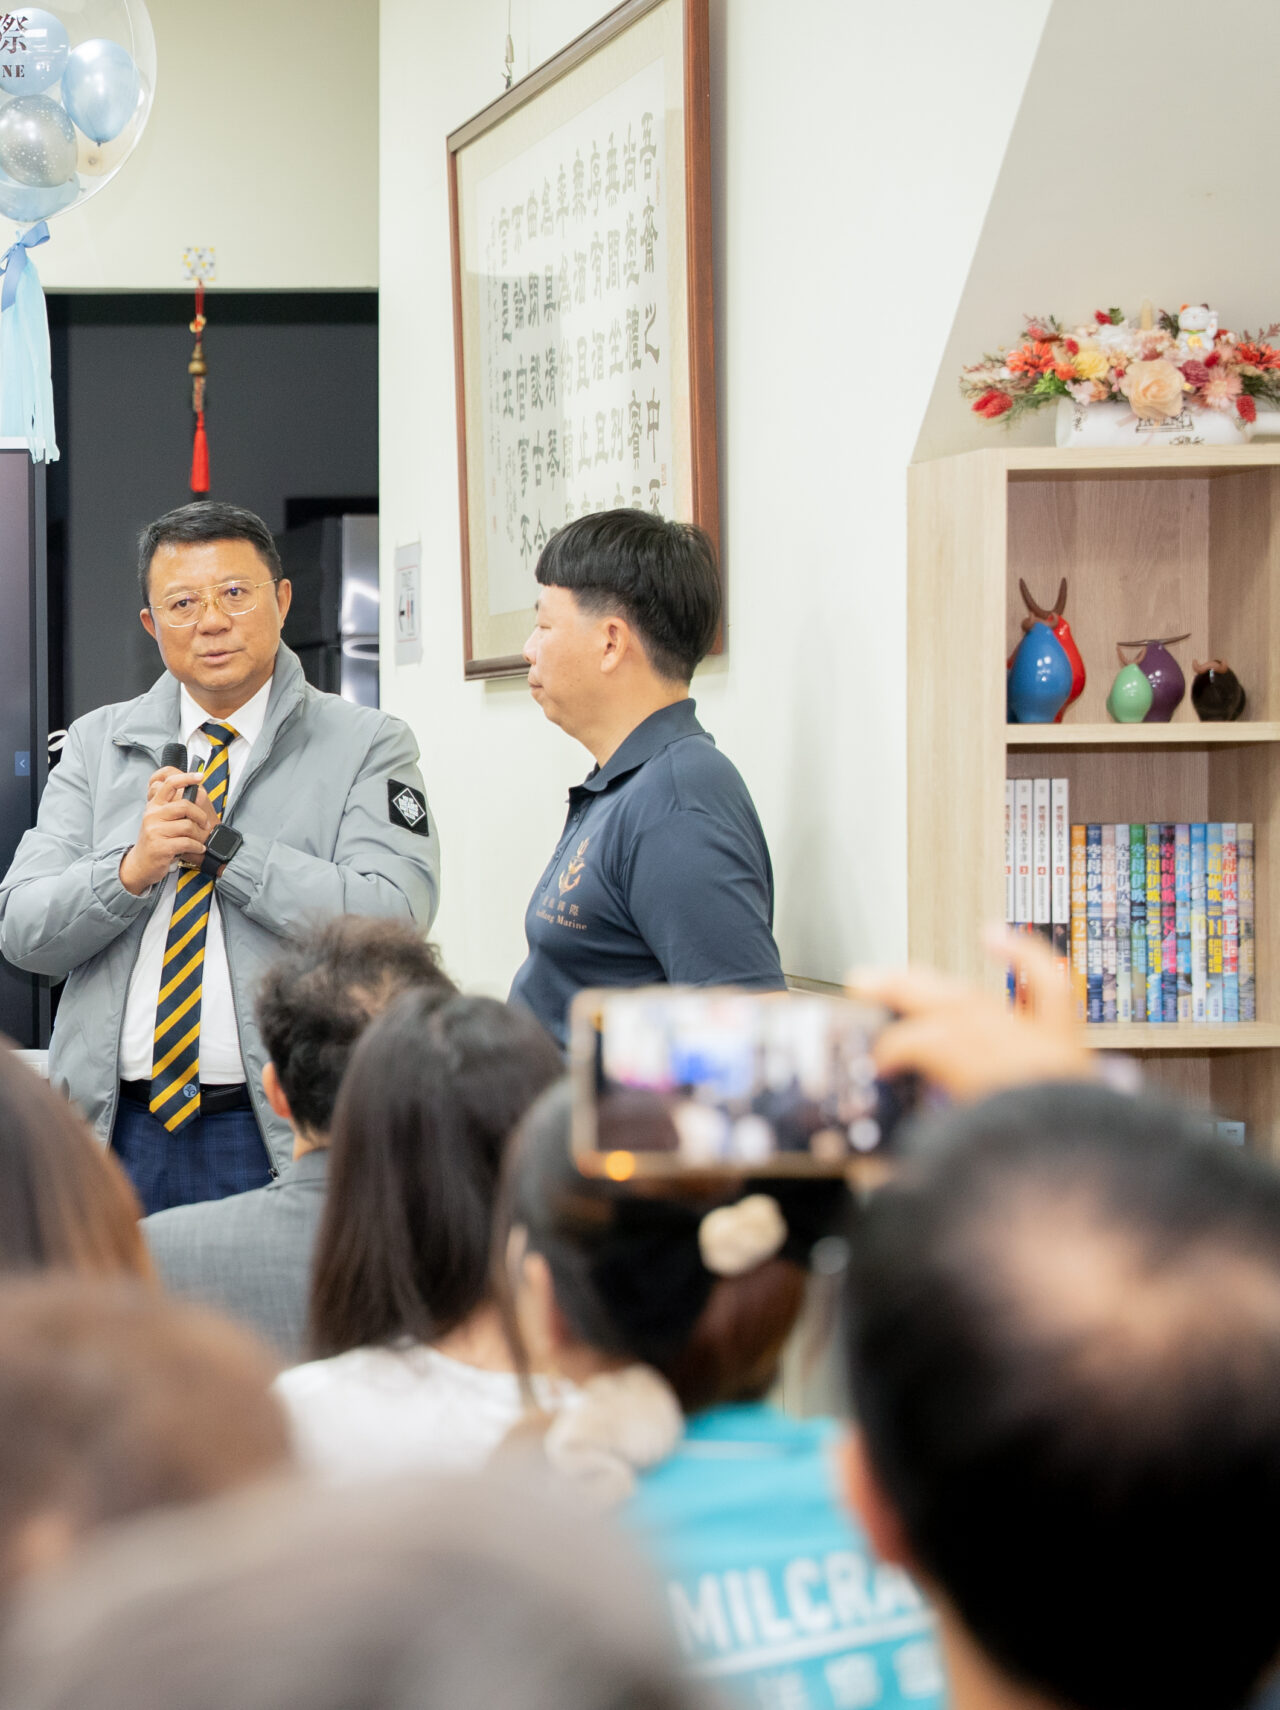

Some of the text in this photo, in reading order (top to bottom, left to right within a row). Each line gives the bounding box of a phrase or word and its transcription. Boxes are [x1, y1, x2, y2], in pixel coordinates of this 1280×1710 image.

[557, 914, 588, 930] Marine
[1074, 920, 1086, 938] 2
[1088, 920, 1102, 937] 3
[1103, 920, 1115, 937] 4
[1208, 919, 1222, 936] 11
